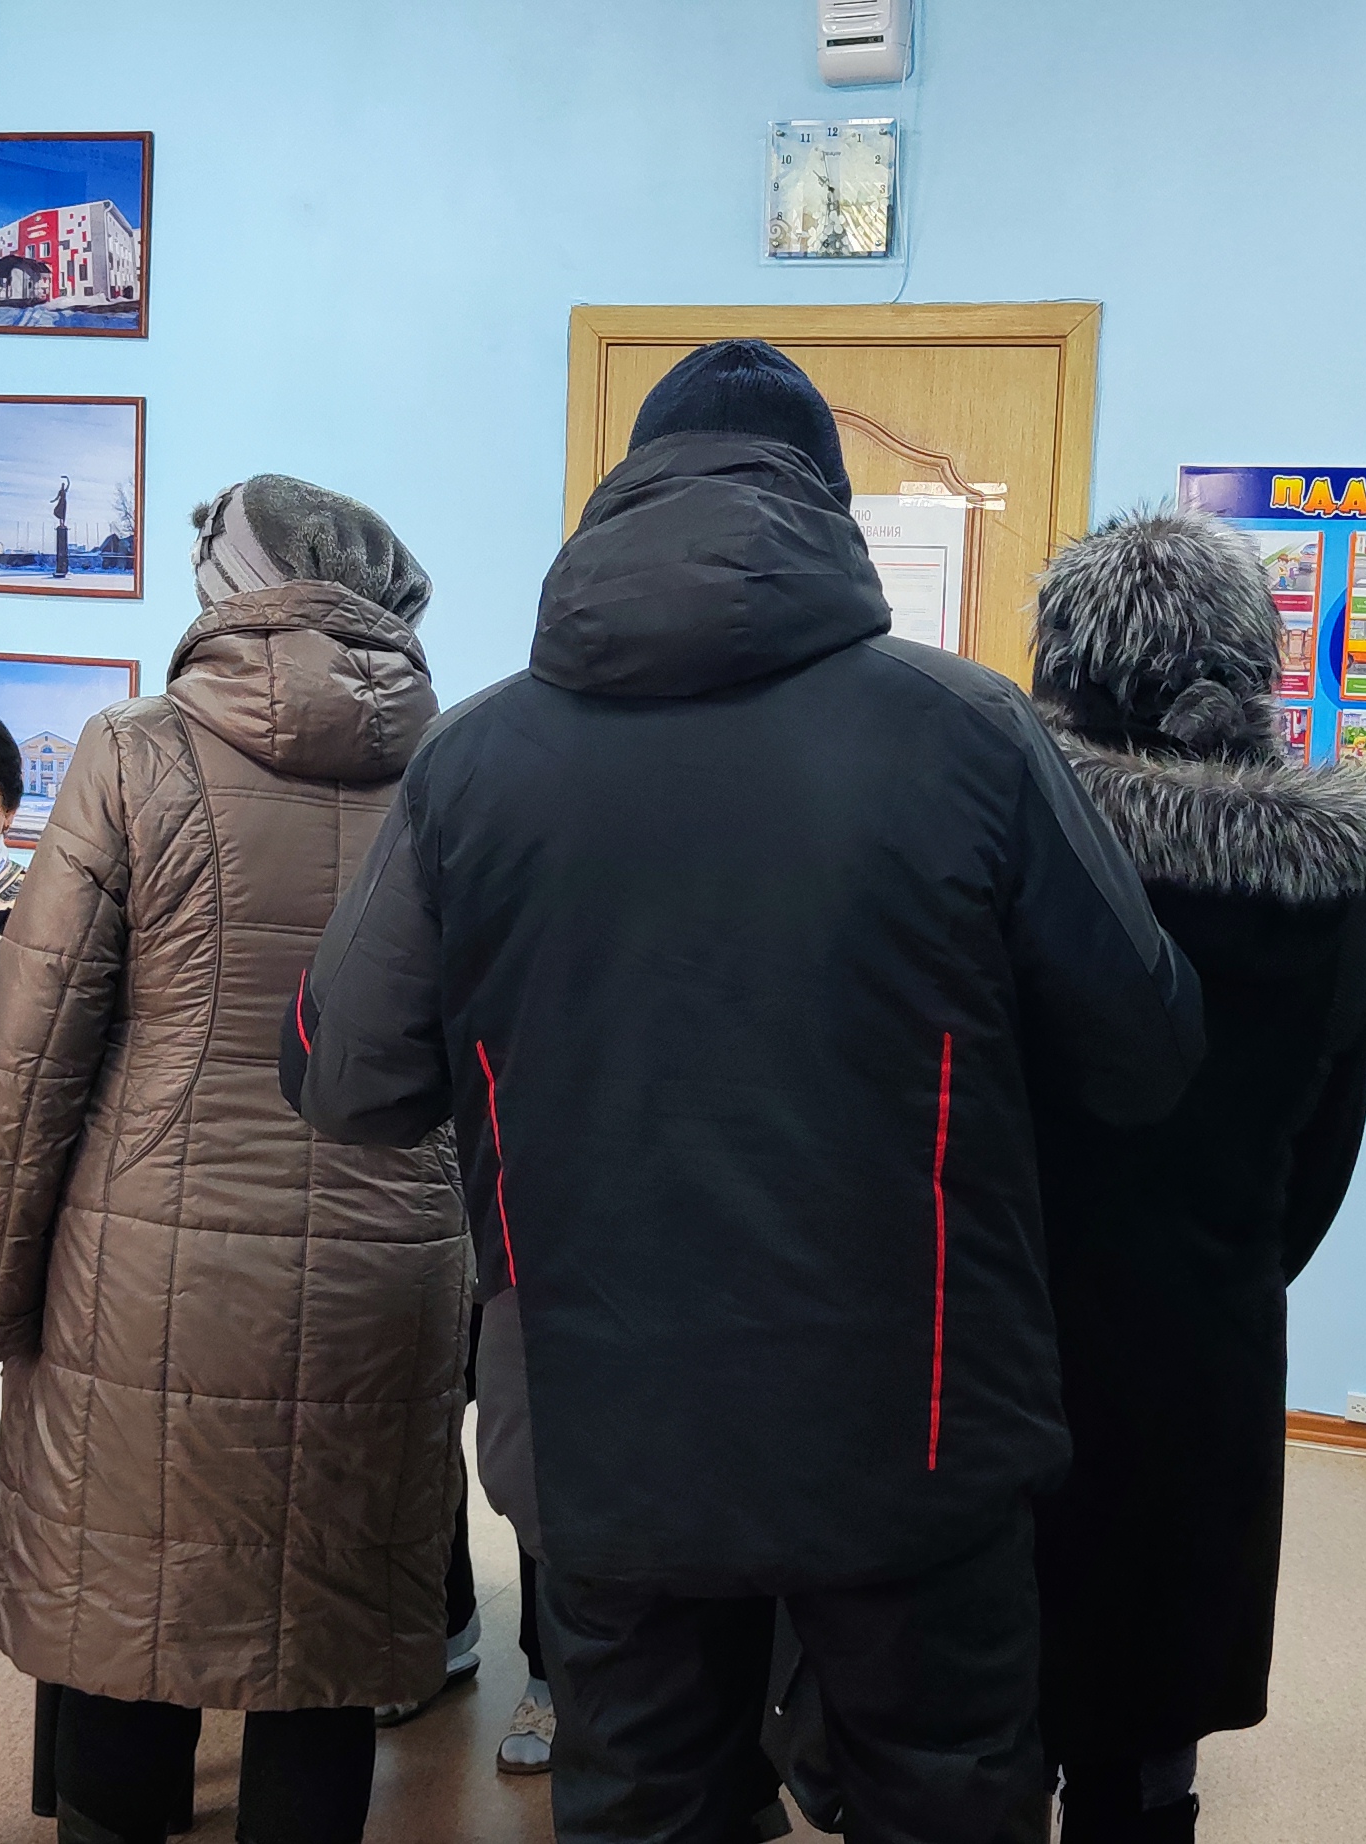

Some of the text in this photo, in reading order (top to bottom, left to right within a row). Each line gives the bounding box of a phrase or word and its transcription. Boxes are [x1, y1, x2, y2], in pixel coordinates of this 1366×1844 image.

[827, 127, 838, 137] 12
[800, 133, 811, 143] 11
[781, 155, 792, 165] 10
[874, 155, 881, 165] 2
[773, 182, 780, 192] 9
